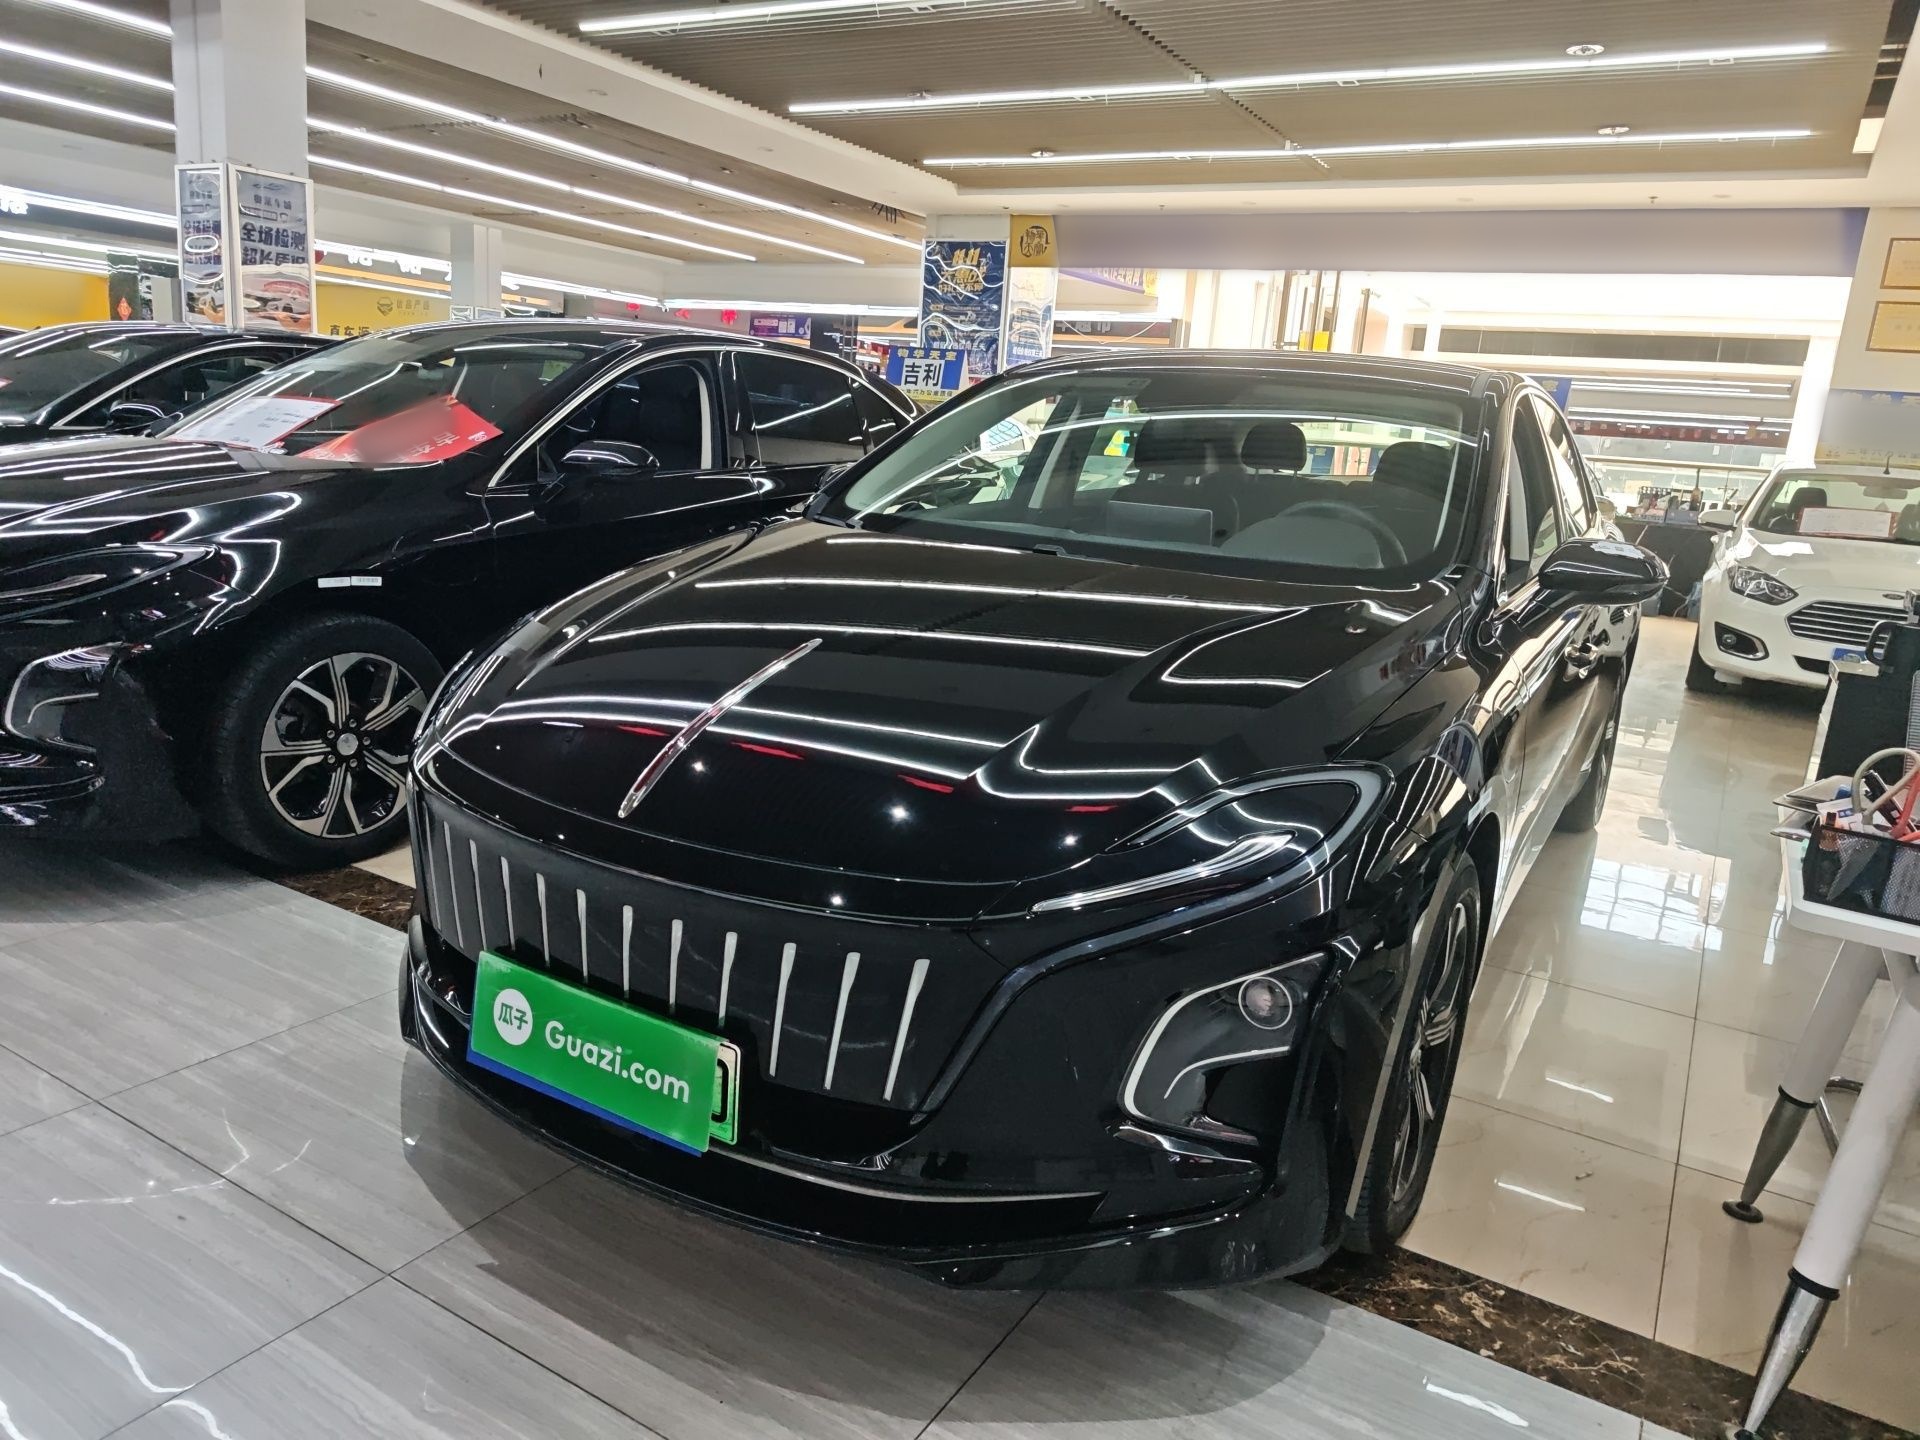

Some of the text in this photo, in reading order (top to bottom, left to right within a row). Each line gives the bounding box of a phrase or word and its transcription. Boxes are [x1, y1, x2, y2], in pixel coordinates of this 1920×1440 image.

[241, 222, 306, 253] 全场检测
[903, 362, 942, 387] 吉利
[497, 1002, 529, 1031] 瓜子
[544, 1020, 690, 1104] Guazi.com
